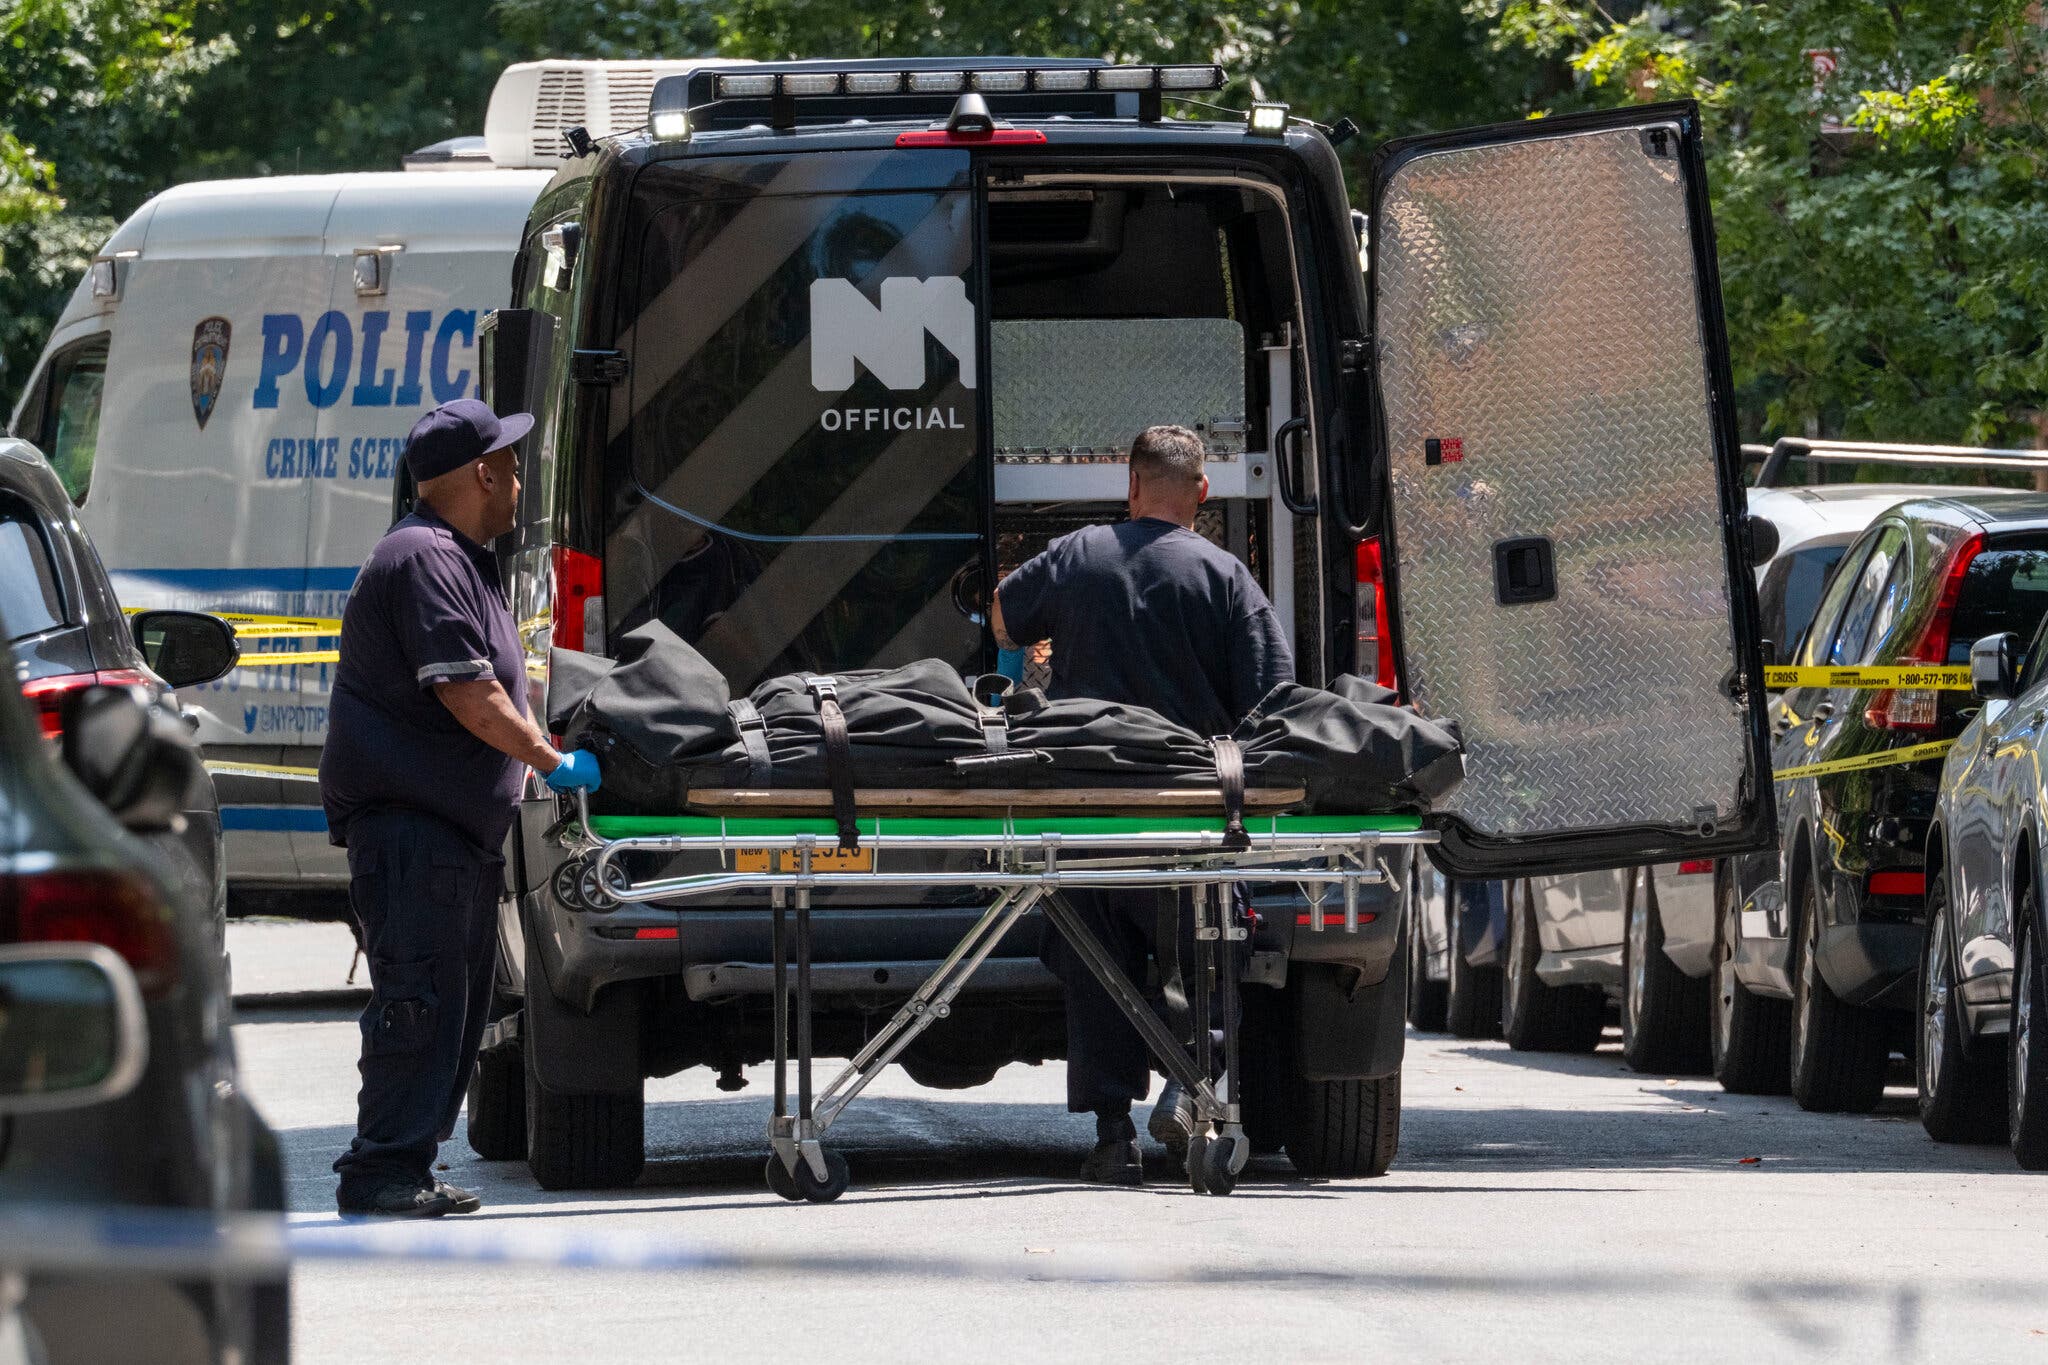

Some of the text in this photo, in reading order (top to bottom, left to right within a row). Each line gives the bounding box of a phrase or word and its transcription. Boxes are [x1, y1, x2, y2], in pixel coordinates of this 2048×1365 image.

[253, 308, 490, 409] POLIC
[820, 407, 965, 431] OFFICIAL
[265, 437, 407, 479] CRIME SCEN
[1772, 671, 1799, 683] CROSS
[1898, 673, 1958, 685] 1-800-577-TIPS
